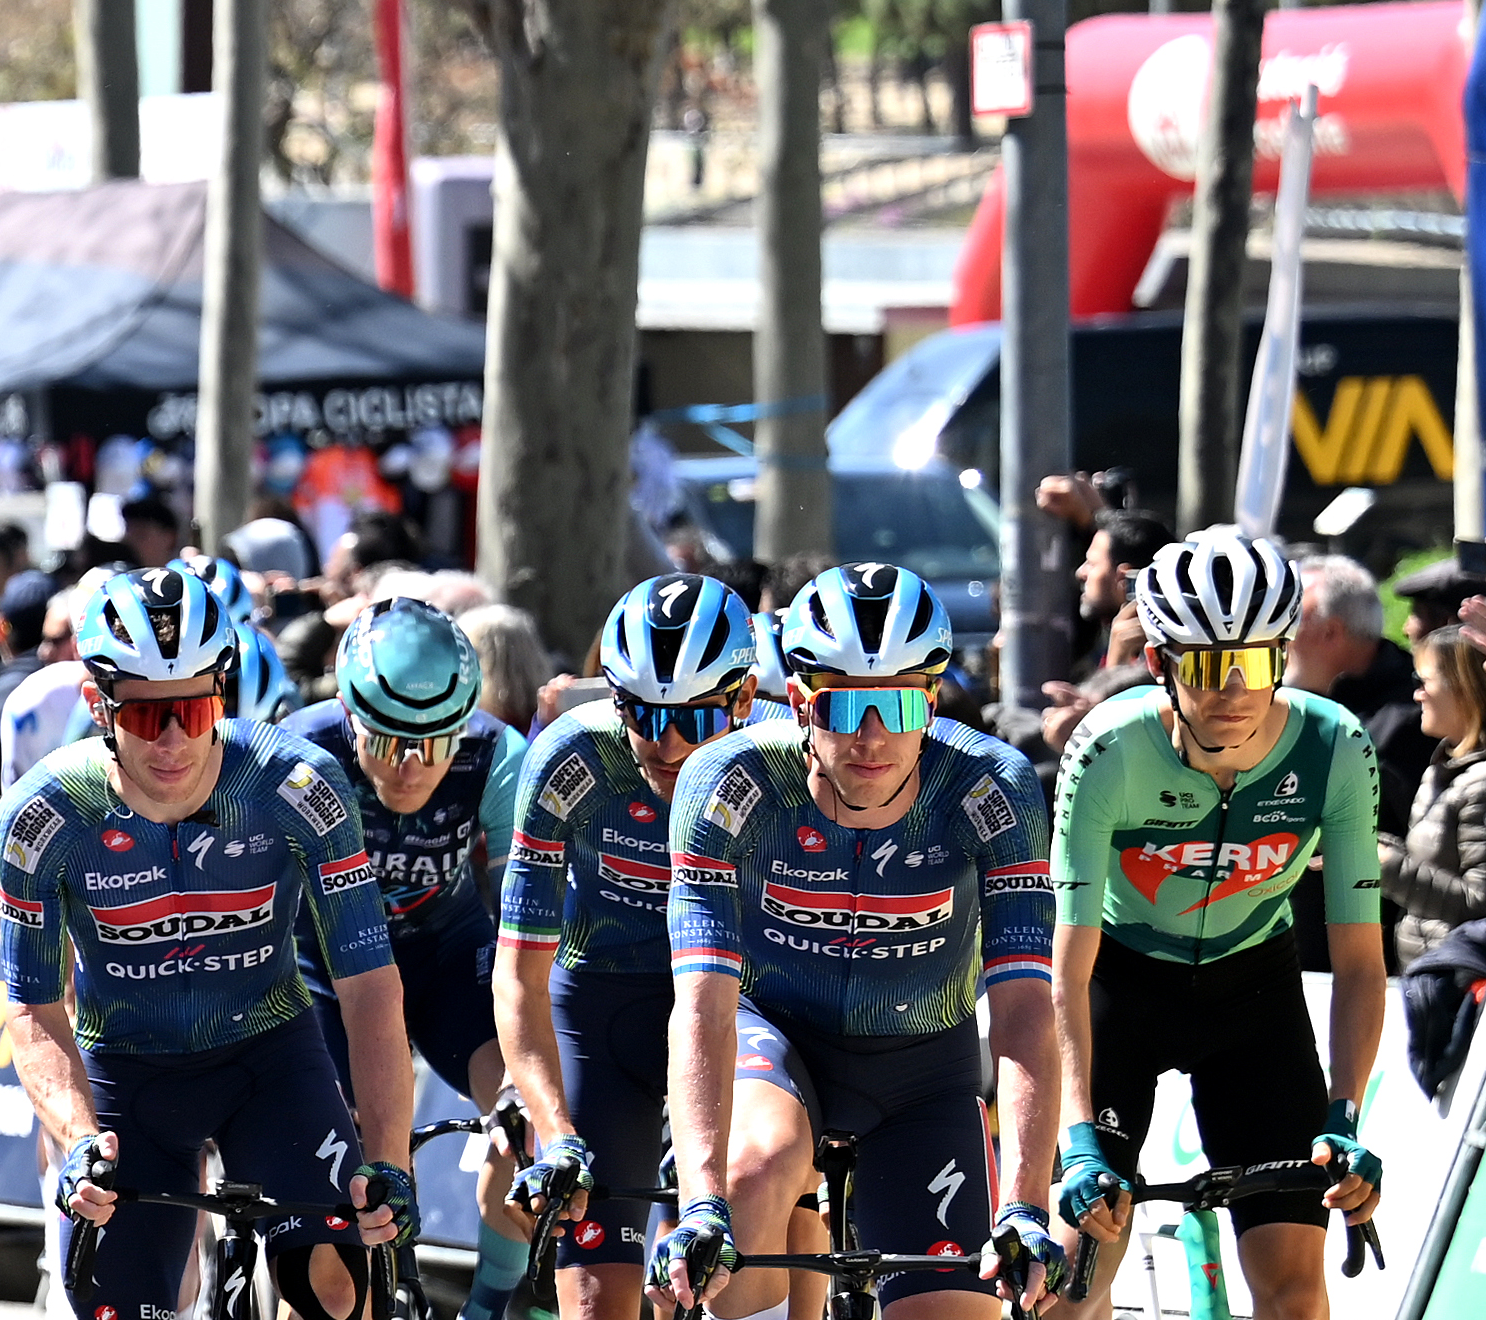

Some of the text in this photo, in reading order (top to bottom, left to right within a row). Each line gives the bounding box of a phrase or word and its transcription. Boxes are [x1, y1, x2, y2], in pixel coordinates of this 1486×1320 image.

[253, 381, 483, 437] OPA CICLISTA
[549, 756, 581, 794] SAFETY
[557, 765, 590, 802] JOGGER
[716, 764, 743, 802] SAFETY
[1058, 741, 1107, 837] PHARMA
[302, 786, 337, 830] JOGGER
[312, 778, 346, 824] SAFETY
[727, 776, 755, 812] JOGGER
[986, 789, 1015, 826] SAFETY
[1256, 796, 1306, 807] ETXEONDO
[11, 798, 45, 841] SAFETY
[21, 808, 57, 853] JOGGER
[976, 798, 1002, 835] JOGGER
[1143, 818, 1199, 828] GIANT
[1252, 814, 1280, 823] BCD
[248, 833, 274, 854] UCI WORLD TEAM
[927, 845, 950, 866] UCI WORLD TEAM
[1143, 841, 1290, 871] KERN
[85, 865, 168, 891] Ekopak
[322, 864, 377, 893] SOUDA
[600, 866, 670, 894] SOU
[672, 868, 738, 885] SOUDAL
[772, 859, 850, 883] Ekopak
[985, 875, 1055, 894] SOUDAL
[0, 901, 43, 928] UDAL
[501, 903, 556, 918] NSTANTIA
[683, 918, 726, 930] KLEIN
[763, 901, 951, 932] SOUDAL
[98, 907, 271, 943] SOUDAL
[1003, 925, 1045, 937] KLEIN
[1244, 1159, 1309, 1176] GIANT
[621, 1227, 645, 1243] Eko
